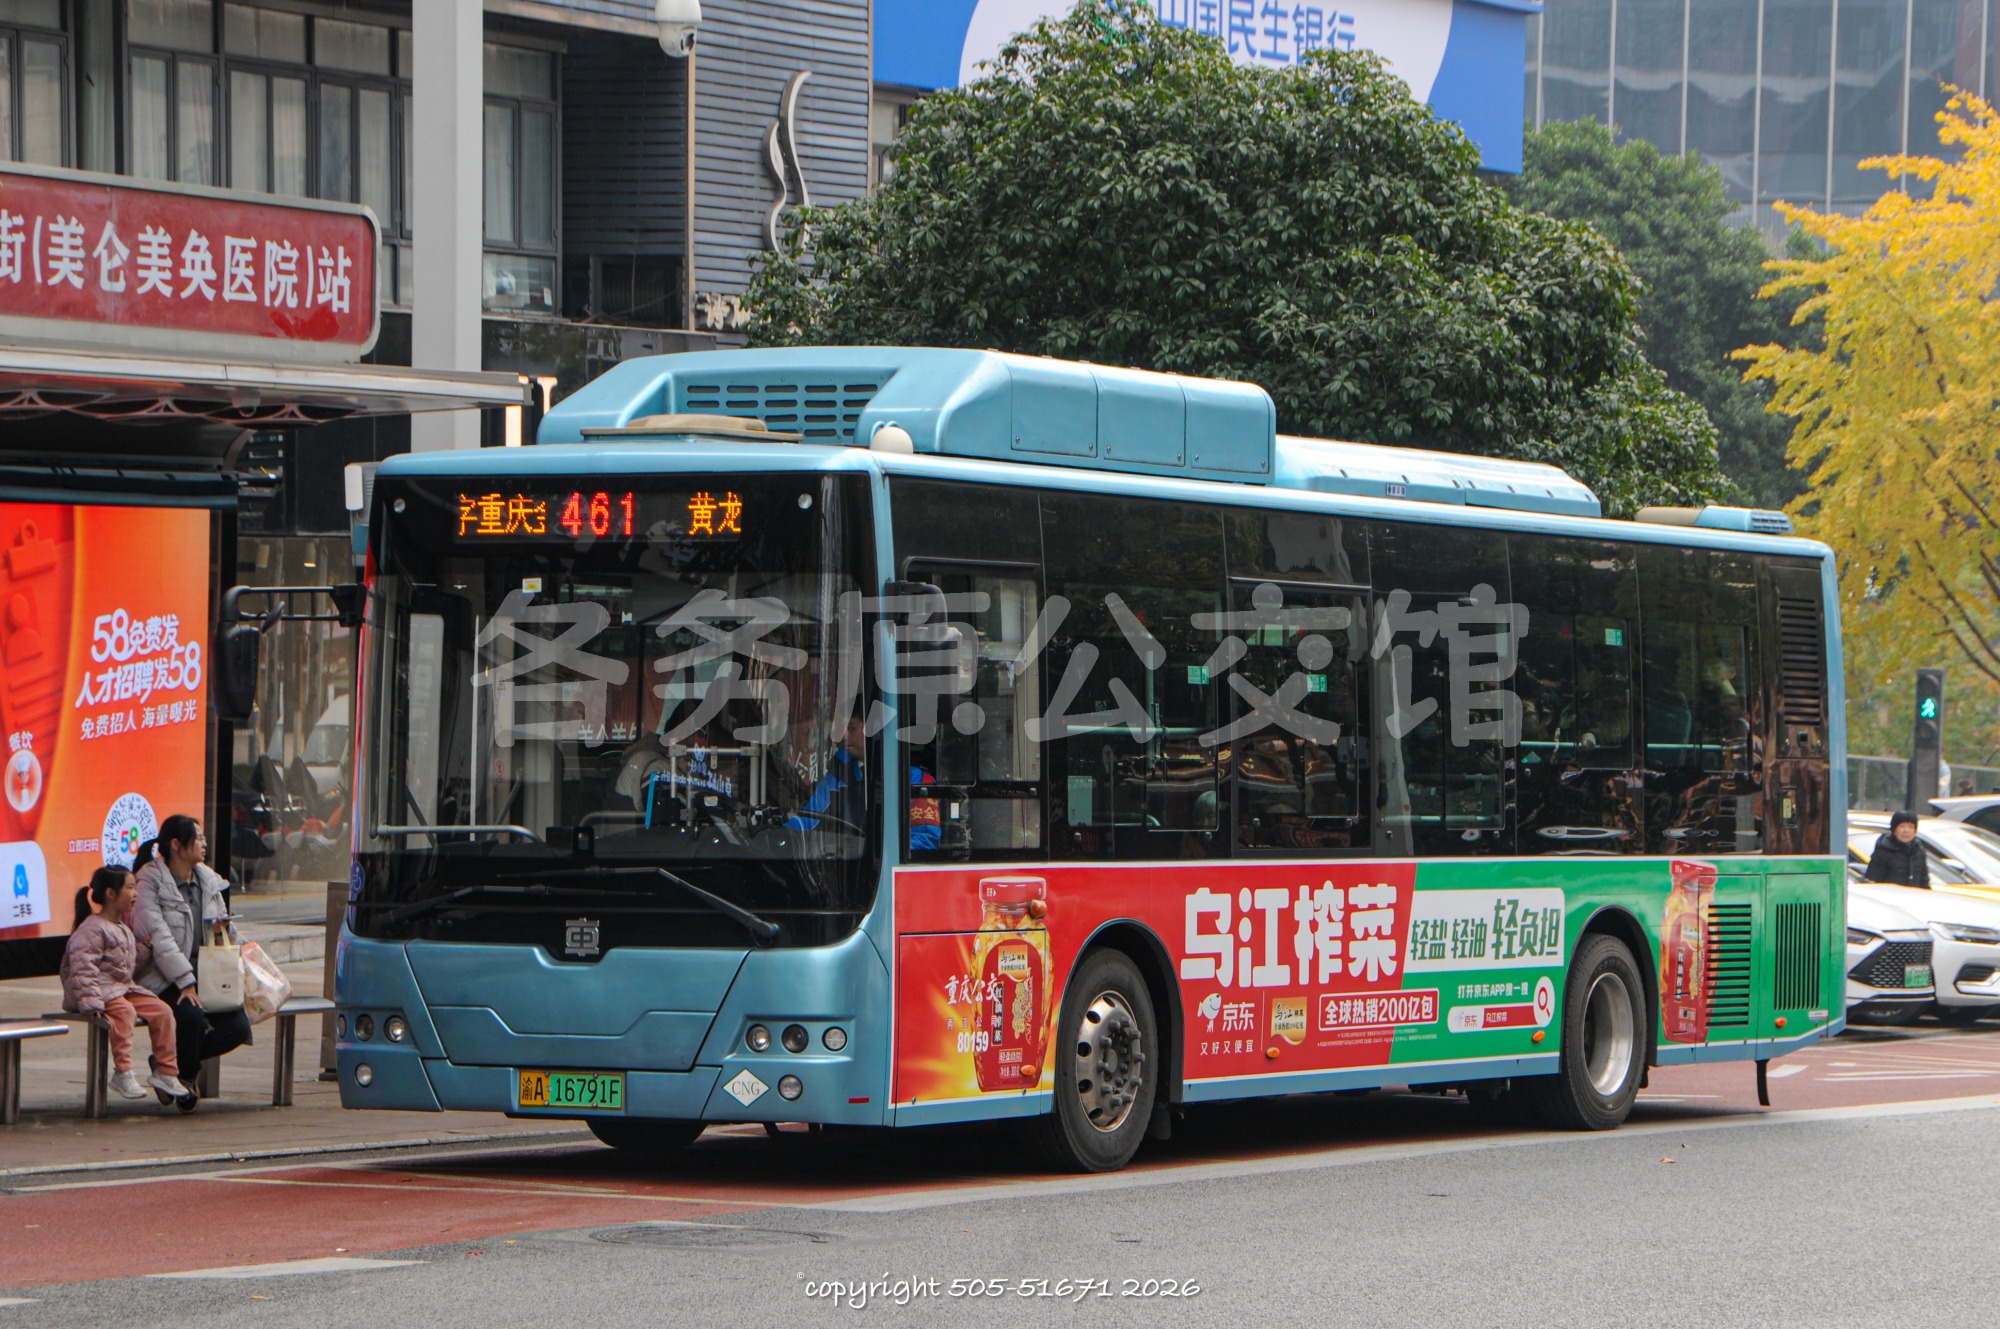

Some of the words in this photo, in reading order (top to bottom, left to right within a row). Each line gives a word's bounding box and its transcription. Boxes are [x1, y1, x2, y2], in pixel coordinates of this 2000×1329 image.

[562, 492, 633, 536] 461
[688, 491, 742, 535] 黄龙
[91, 608, 179, 662] 58免费发
[75, 641, 201, 708] 人才招聘发58
[80, 709, 137, 740] 免费招人
[141, 699, 197, 728] 海量曝光
[1180, 880, 1398, 988] 乌江榨菜
[945, 972, 1001, 1005] 重庆公交
[1222, 1002, 1256, 1031] 京东
[1325, 995, 1433, 1025] 全球热销200亿包
[957, 1031, 989, 1053] 80159
[1200, 1039, 1254, 1056] 又好又便宜
[731, 1081, 760, 1096] CNG
